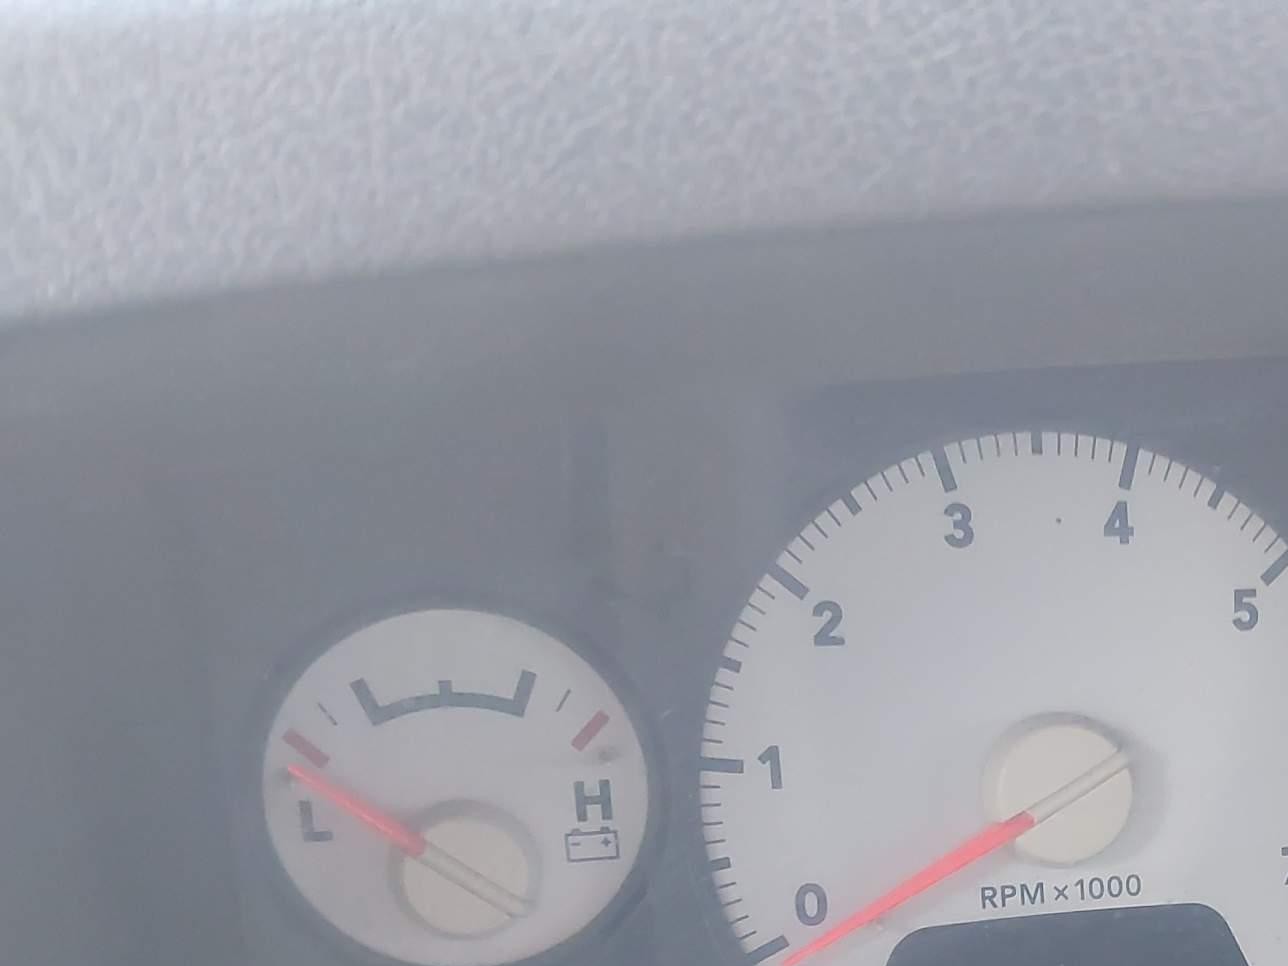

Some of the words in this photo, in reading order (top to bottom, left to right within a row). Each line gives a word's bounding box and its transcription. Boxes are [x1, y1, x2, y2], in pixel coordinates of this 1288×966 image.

[943, 502, 975, 548] 3
[1103, 500, 1134, 545] 4
[812, 600, 845, 647] 2
[1231, 588, 1259, 631] 5
[757, 745, 783, 790] 1
[300, 799, 333, 842] L
[573, 779, 613, 822] H
[794, 883, 828, 927] 0
[980, 882, 1046, 910] RPM
